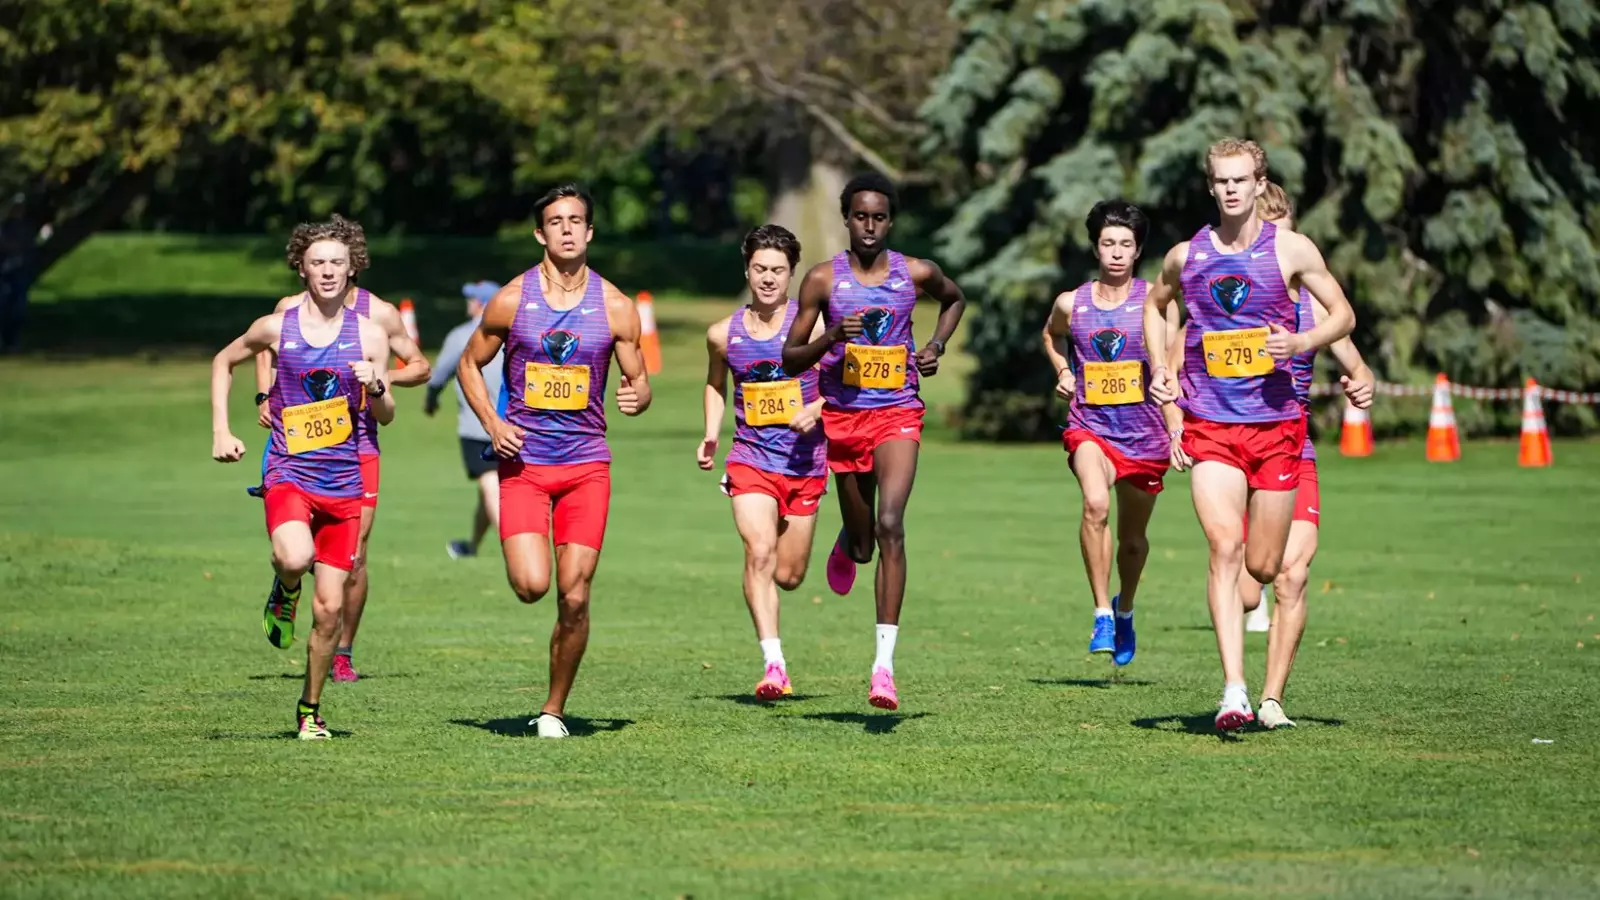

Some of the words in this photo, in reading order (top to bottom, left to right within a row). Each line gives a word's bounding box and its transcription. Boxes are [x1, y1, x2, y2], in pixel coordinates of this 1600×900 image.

[1224, 347, 1252, 366] 279
[863, 362, 890, 379] 278
[543, 381, 571, 399] 280
[1101, 377, 1126, 394] 286
[759, 398, 785, 415] 284
[304, 418, 333, 439] 283
